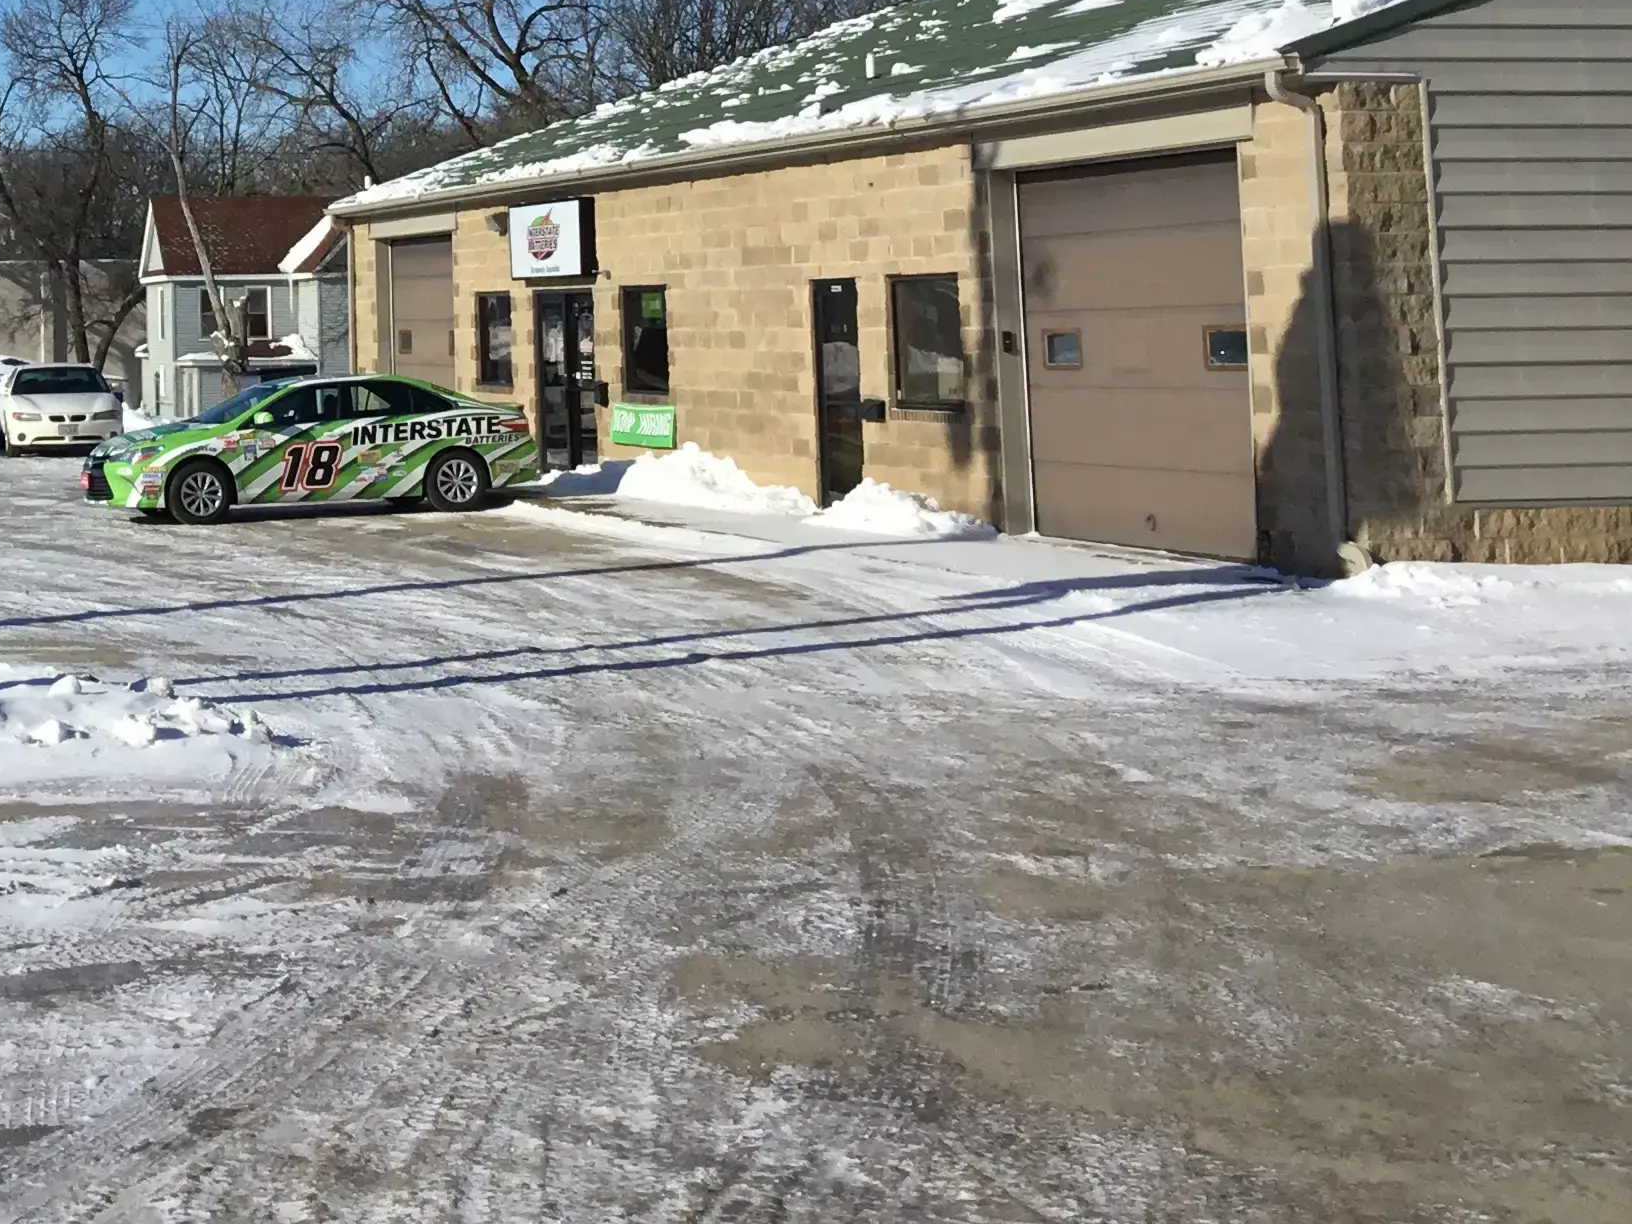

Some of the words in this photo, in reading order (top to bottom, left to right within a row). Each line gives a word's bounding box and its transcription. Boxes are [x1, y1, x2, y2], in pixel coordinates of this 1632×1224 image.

[528, 225, 560, 237] INTERSTATE
[352, 416, 501, 446] INTERSTATE
[636, 412, 672, 437] HIRING
[464, 433, 521, 445] BATTERIES
[282, 443, 343, 490] 18
